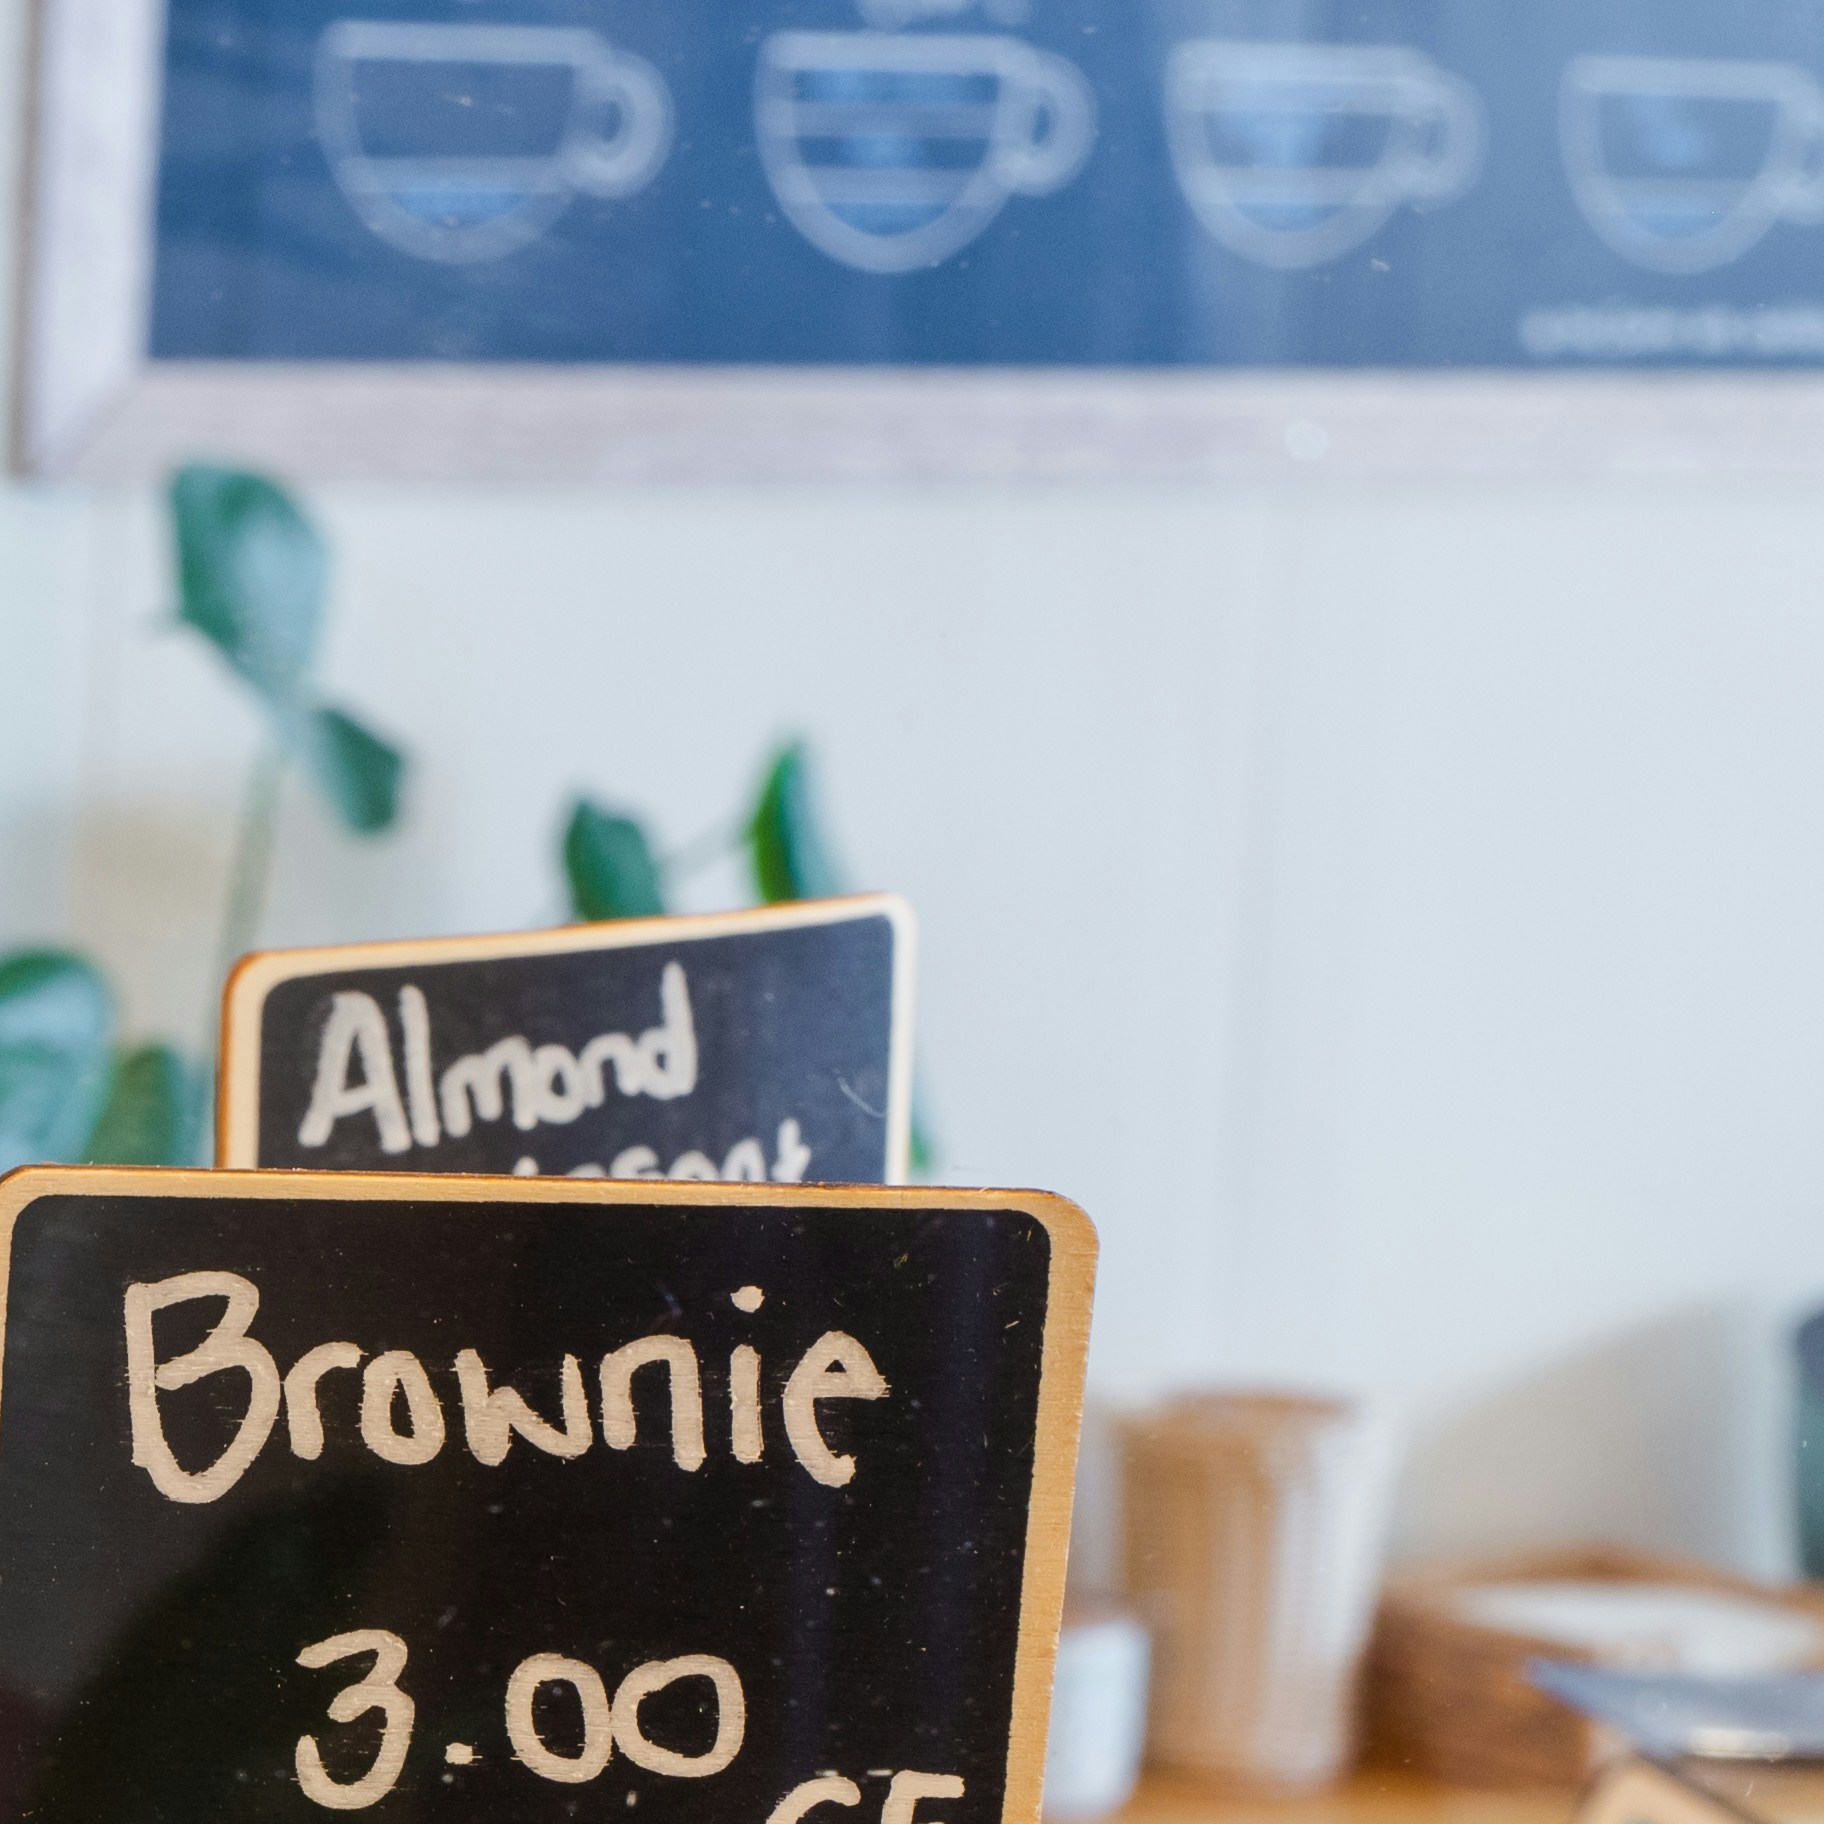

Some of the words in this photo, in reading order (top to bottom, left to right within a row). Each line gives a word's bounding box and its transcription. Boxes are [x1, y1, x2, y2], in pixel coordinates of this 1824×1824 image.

[297, 960, 700, 1155] Almond
[122, 1270, 892, 1504] Brownie
[292, 1629, 747, 1811] 3.00
